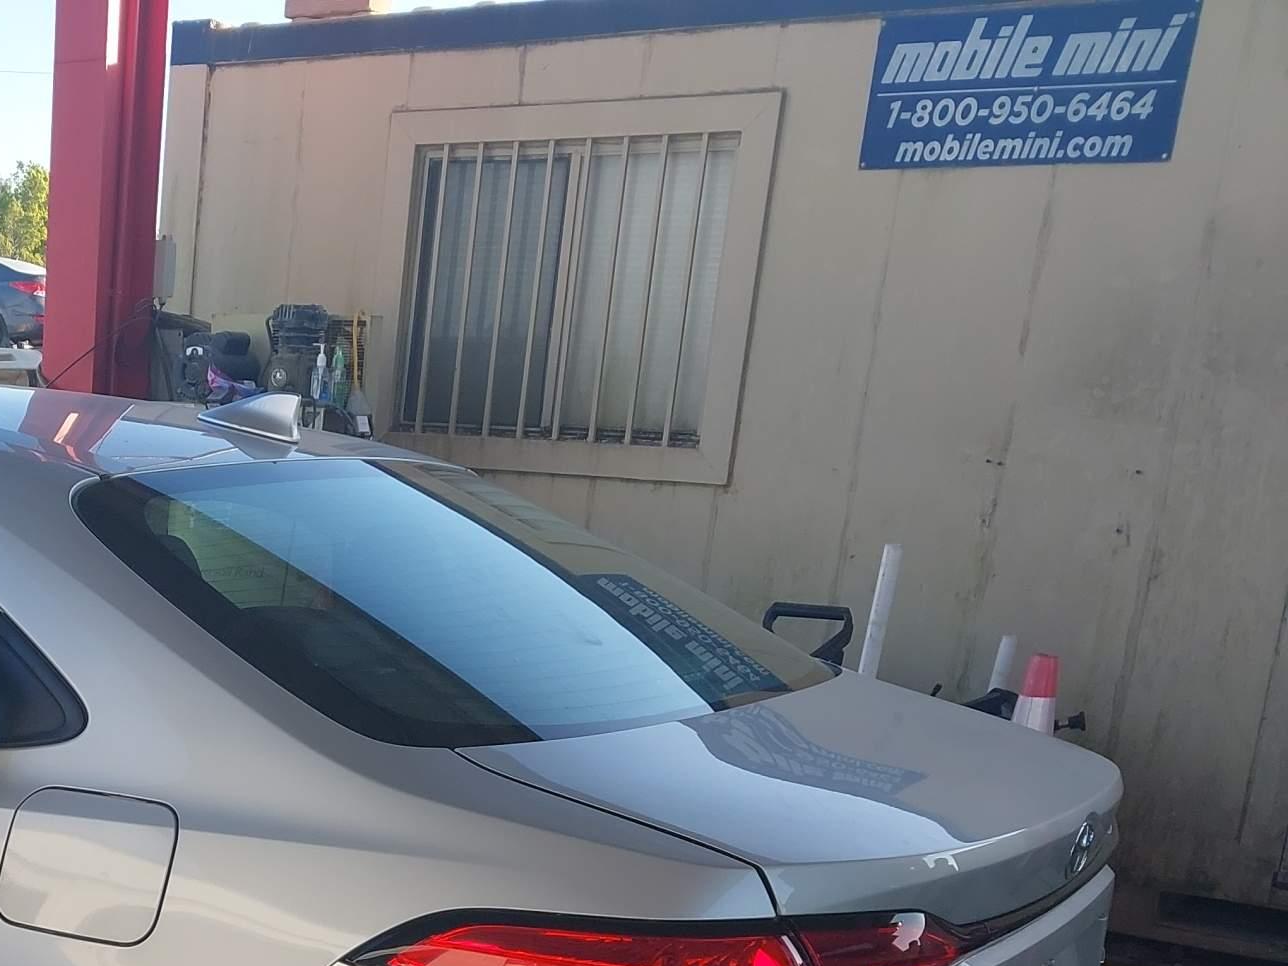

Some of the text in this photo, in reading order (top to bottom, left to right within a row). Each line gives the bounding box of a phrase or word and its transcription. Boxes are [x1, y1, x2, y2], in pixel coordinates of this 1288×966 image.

[881, 13, 1188, 84] mobile mini
[886, 89, 1158, 129] 1-800-950-6464
[895, 130, 1133, 162] mobilemini.com
